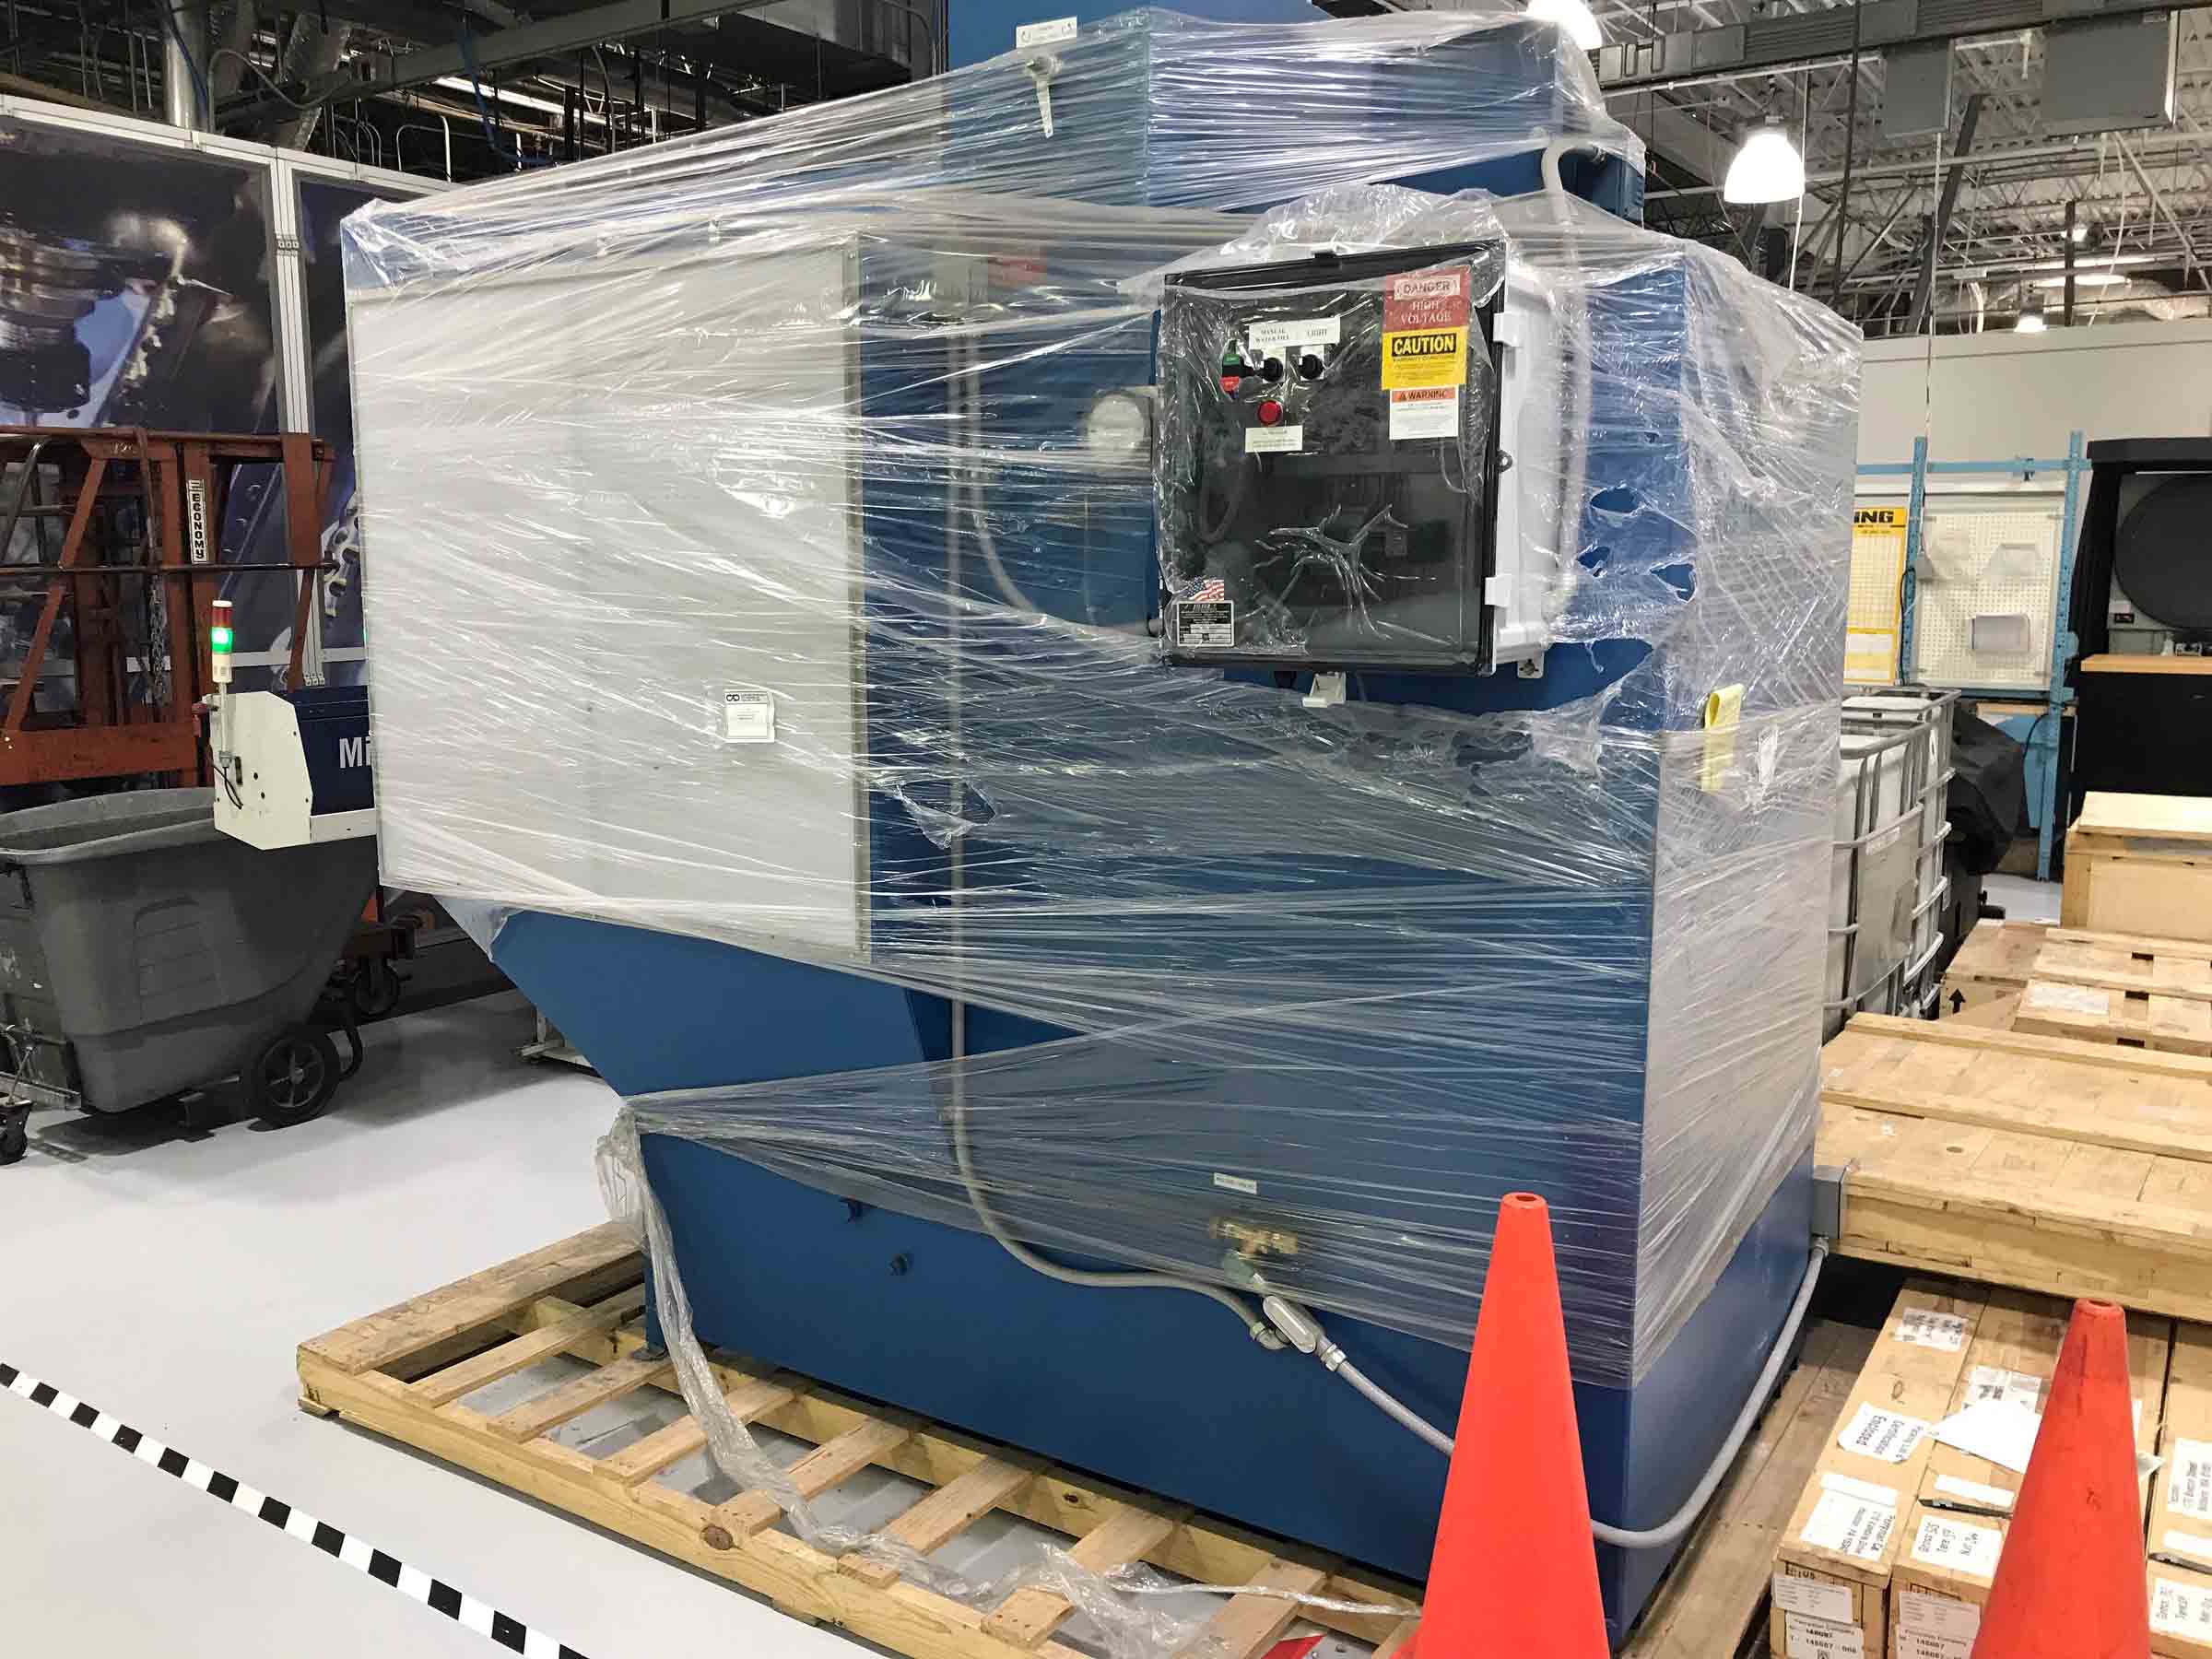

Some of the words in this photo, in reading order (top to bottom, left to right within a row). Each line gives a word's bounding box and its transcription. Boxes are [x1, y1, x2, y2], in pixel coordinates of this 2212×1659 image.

[1403, 280, 1451, 294] DANGER
[1411, 300, 1439, 311] HIGH
[1400, 311, 1453, 325] VOLTAGE
[1307, 328, 1328, 336] LIGHT
[1394, 335, 1454, 355] CAUTION
[1853, 511, 1894, 524] ING
[191, 493, 205, 559] ECONOMY
[339, 735, 371, 769] Mi
[1855, 1415, 1888, 1446] Enclosed
